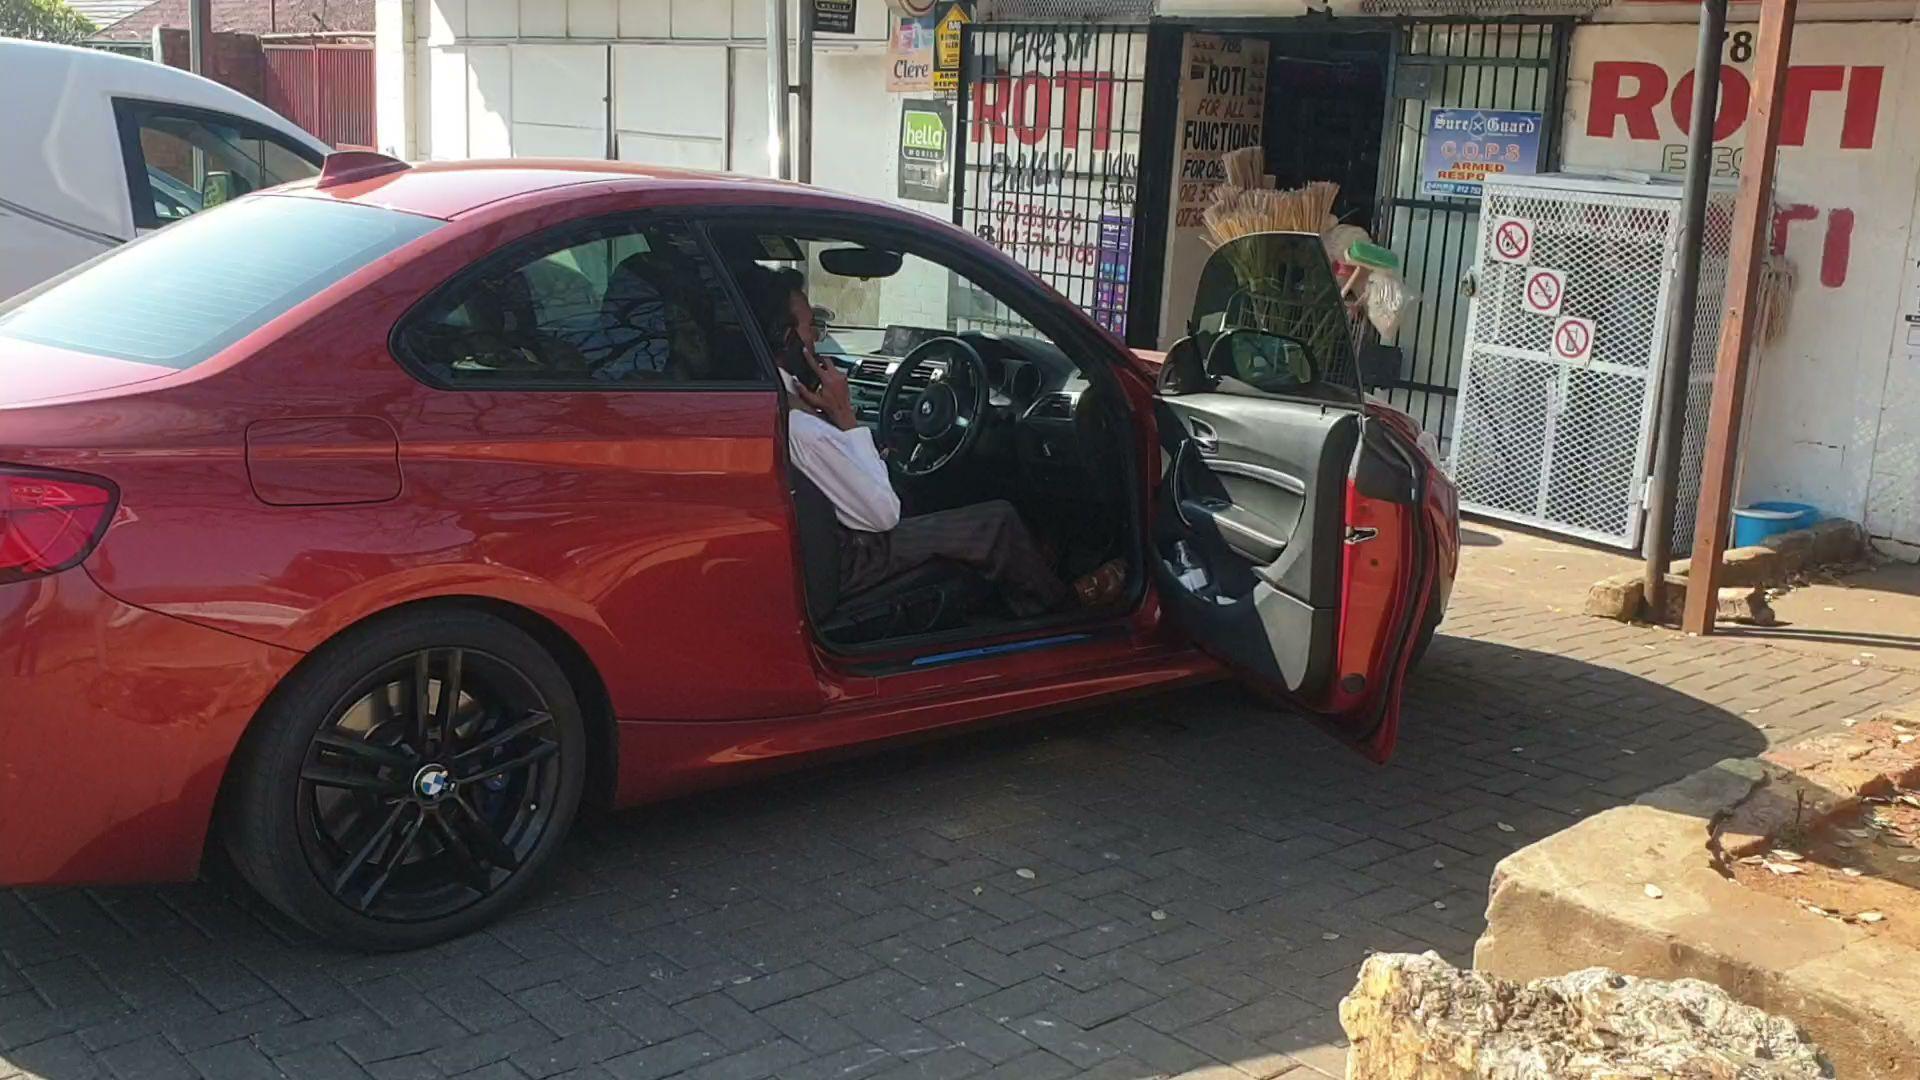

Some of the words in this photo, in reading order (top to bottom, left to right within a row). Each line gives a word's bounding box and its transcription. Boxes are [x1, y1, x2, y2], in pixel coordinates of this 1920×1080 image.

[1208, 64, 1246, 97] ROTI
[971, 70, 1115, 150] ROTI
[1197, 97, 1221, 117] FOR
[1223, 100, 1245, 119] ALL
[906, 121, 943, 147] hello
[1434, 113, 1468, 131] Sure
[1487, 117, 1535, 134] Guard
[1184, 120, 1260, 152] FUNCTIONS
[908, 149, 939, 158] MOBILE
[1182, 159, 1205, 179] FOR
[1438, 170, 1486, 181] RESPO
[1451, 161, 1506, 173] ARMED
